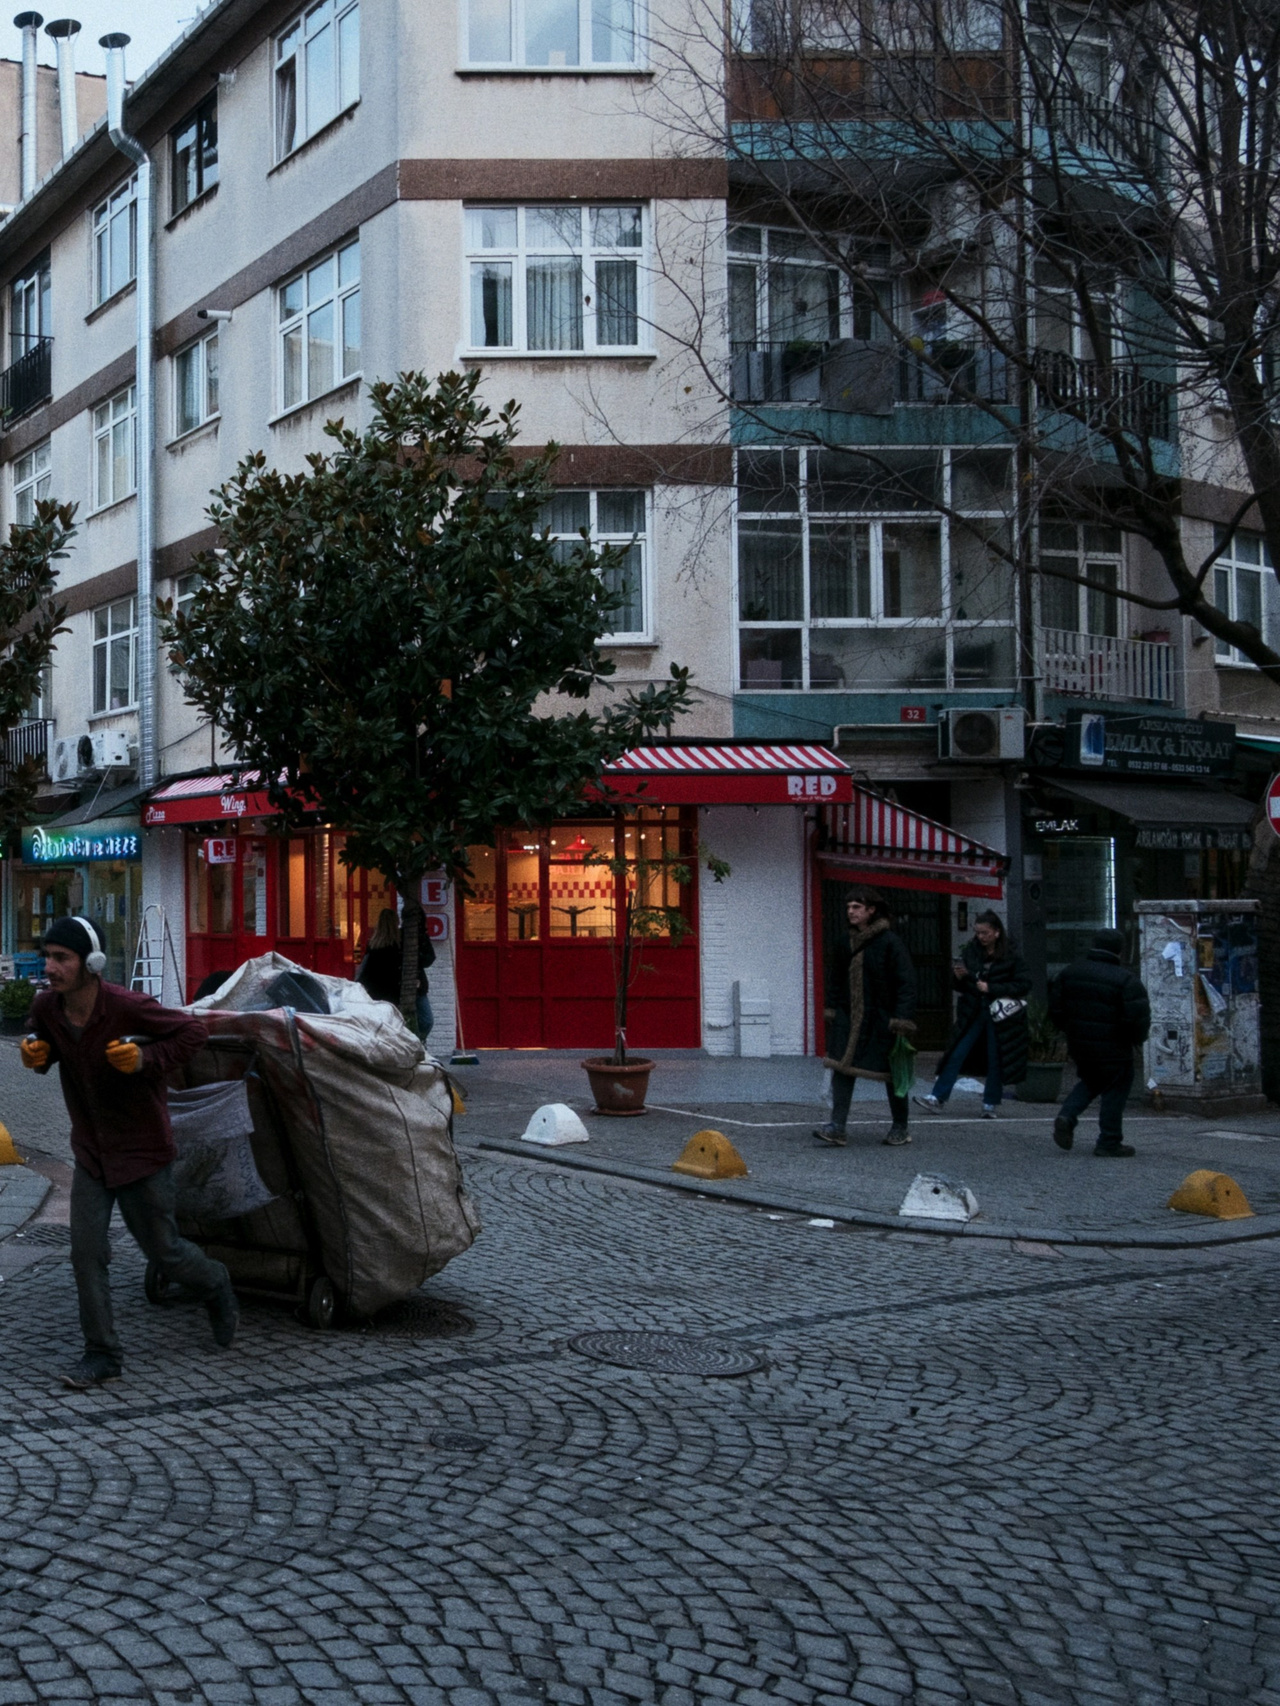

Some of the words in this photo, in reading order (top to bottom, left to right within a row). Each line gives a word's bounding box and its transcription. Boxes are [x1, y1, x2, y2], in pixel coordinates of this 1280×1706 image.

[906, 709, 920, 721] 32
[1138, 719, 1204, 735] ARSLANOĞLU
[1105, 732, 1162, 756] EMLAK
[1163, 737, 1177, 756] &
[1179, 735, 1232, 762] İNŞAAT
[786, 774, 838, 797] RED
[145, 806, 166, 823] Pizza
[1034, 818, 1080, 833] EMLAK
